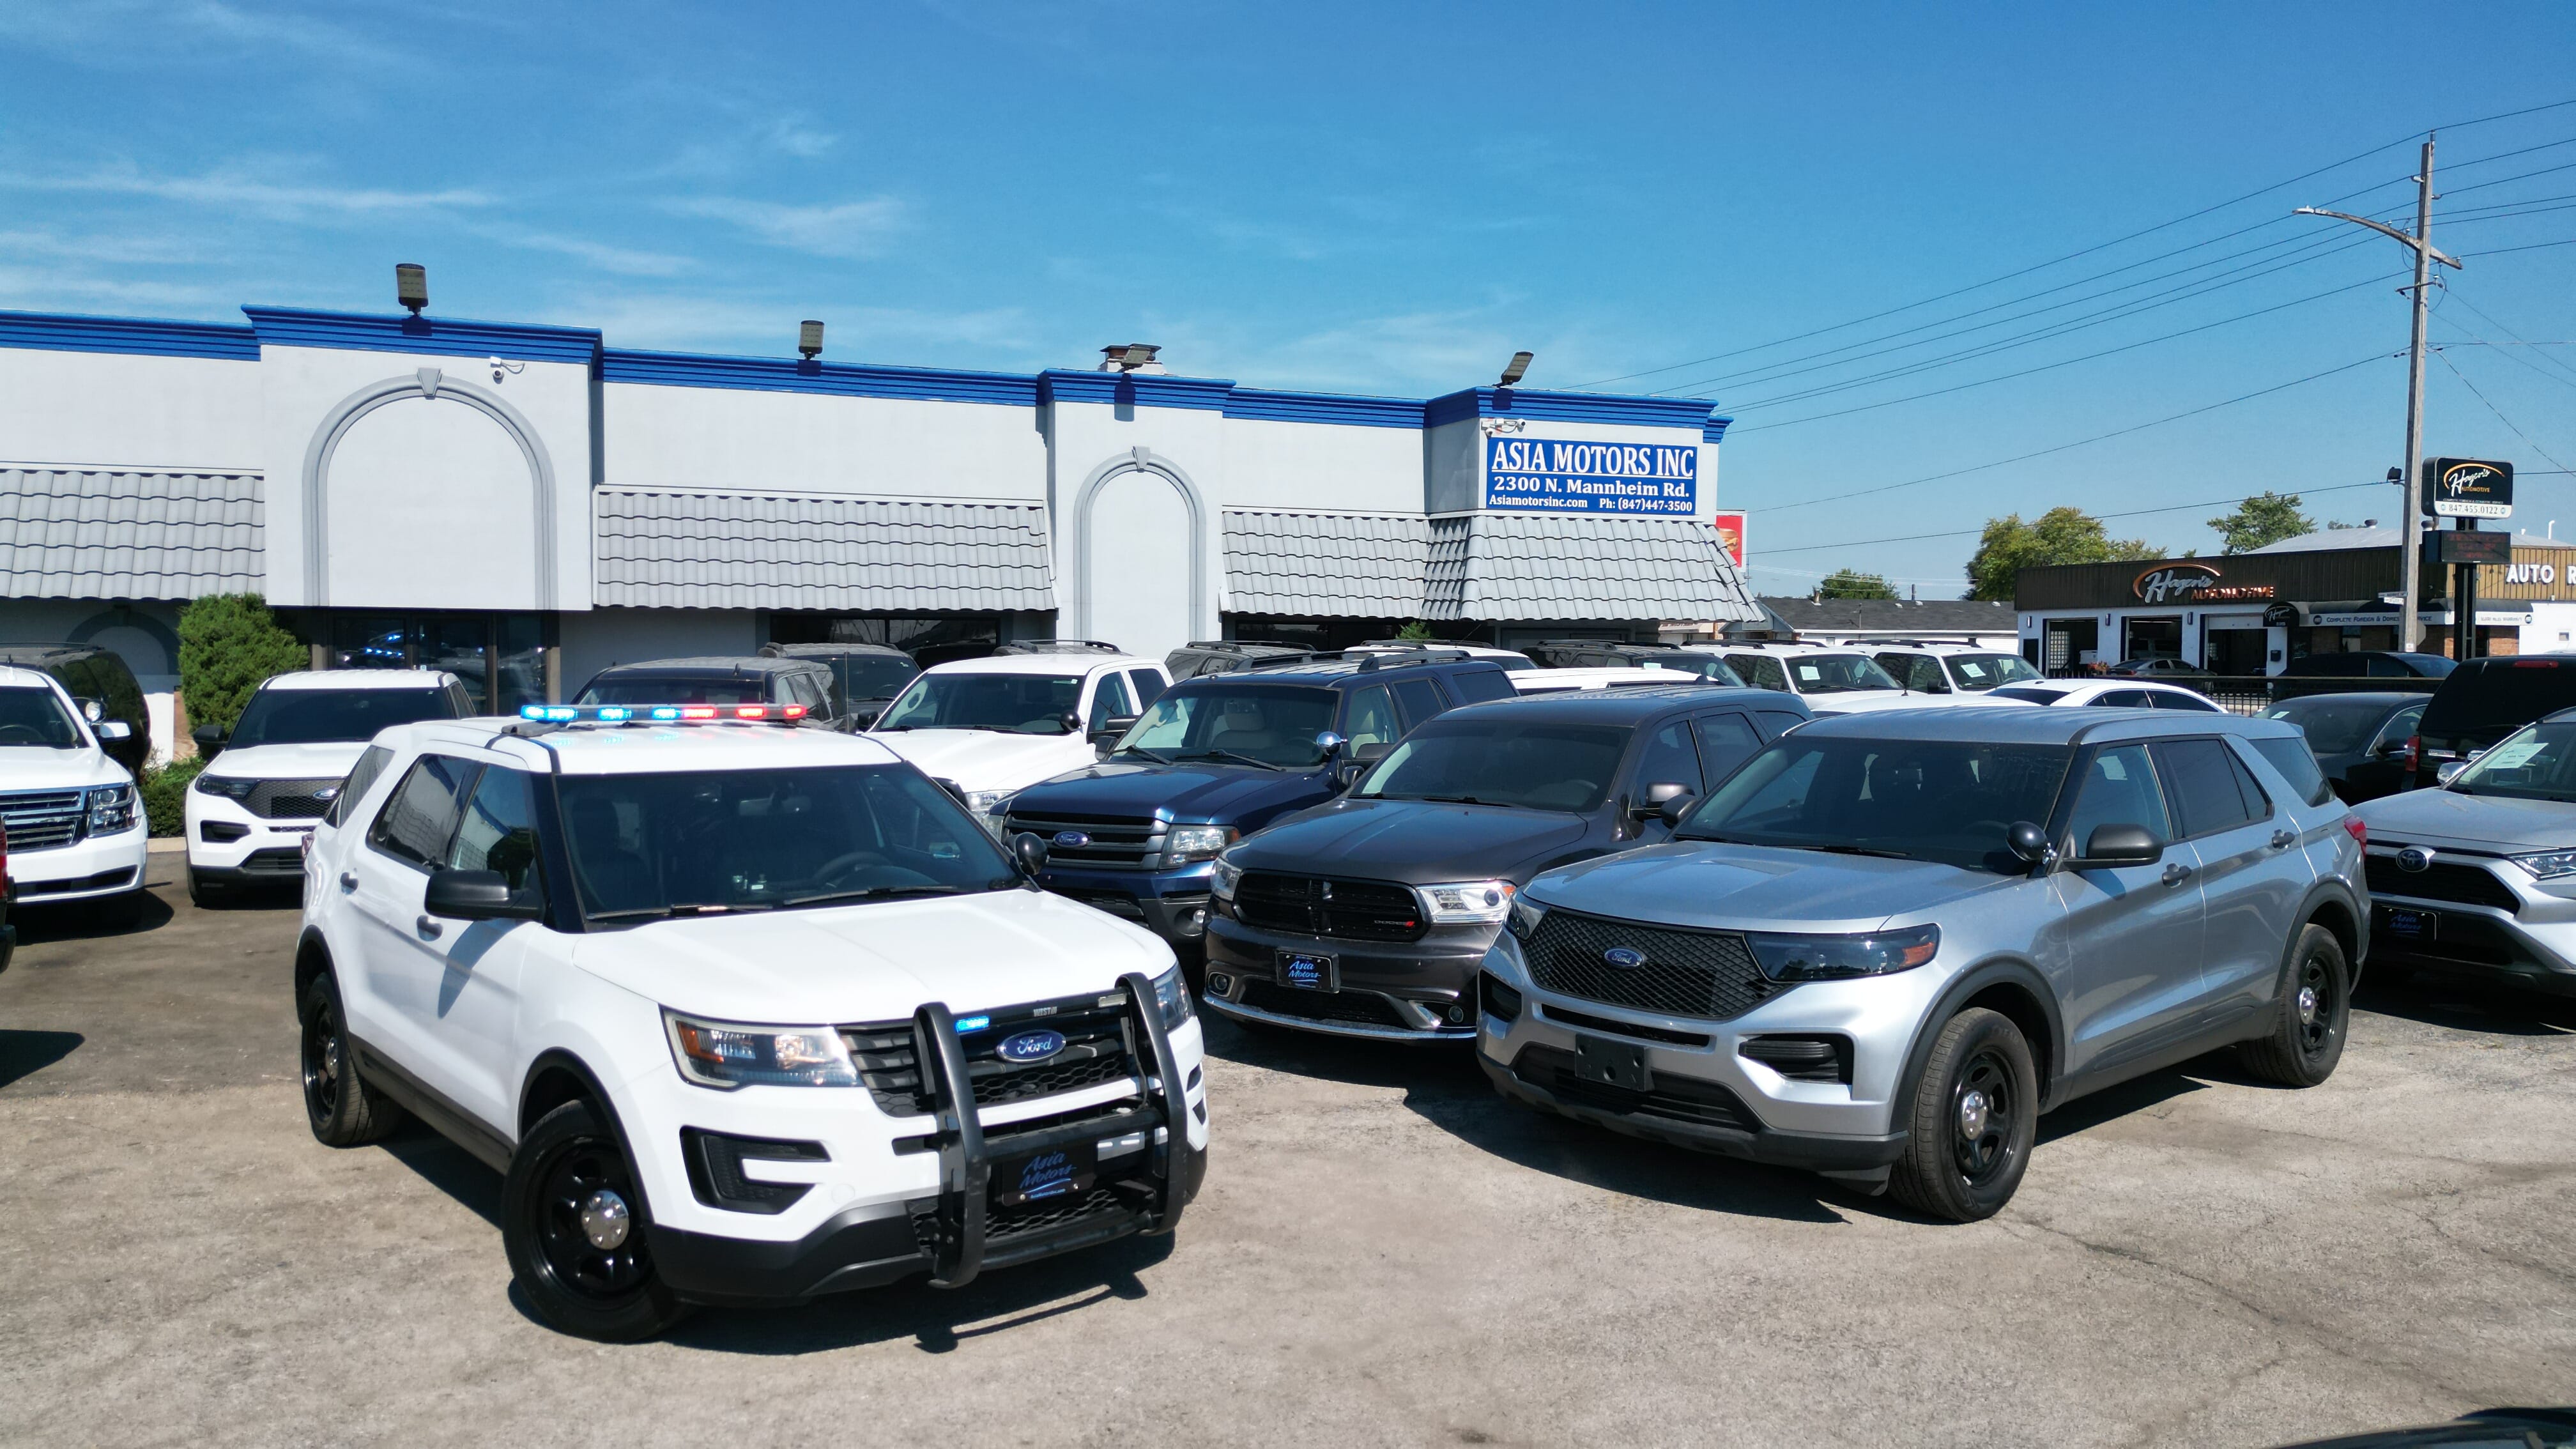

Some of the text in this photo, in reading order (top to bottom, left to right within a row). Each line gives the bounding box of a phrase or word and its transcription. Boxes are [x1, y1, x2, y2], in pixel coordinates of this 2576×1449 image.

[1491, 441, 1694, 477] ASIA MOTORS INC
[1494, 476, 1689, 497] 2300 N. Mannheim Rd.
[2448, 468, 2490, 497] Hagen's
[1489, 494, 1692, 511] Asiamotorsinc.com Ph: (847)447-3500
[2449, 504, 2498, 514] 847.455.0122
[2506, 564, 2554, 583] AUTO
[2145, 570, 2214, 602] Hagen's
[2191, 586, 2274, 600] AUTOMOTIVE
[1289, 960, 1314, 970] Asia
[1611, 951, 1632, 963] Ford
[1288, 970, 1322, 978] Motors
[1017, 1036, 1054, 1054] Ford
[1023, 1151, 1065, 1175] Asia
[1020, 1164, 1077, 1188] Motors
